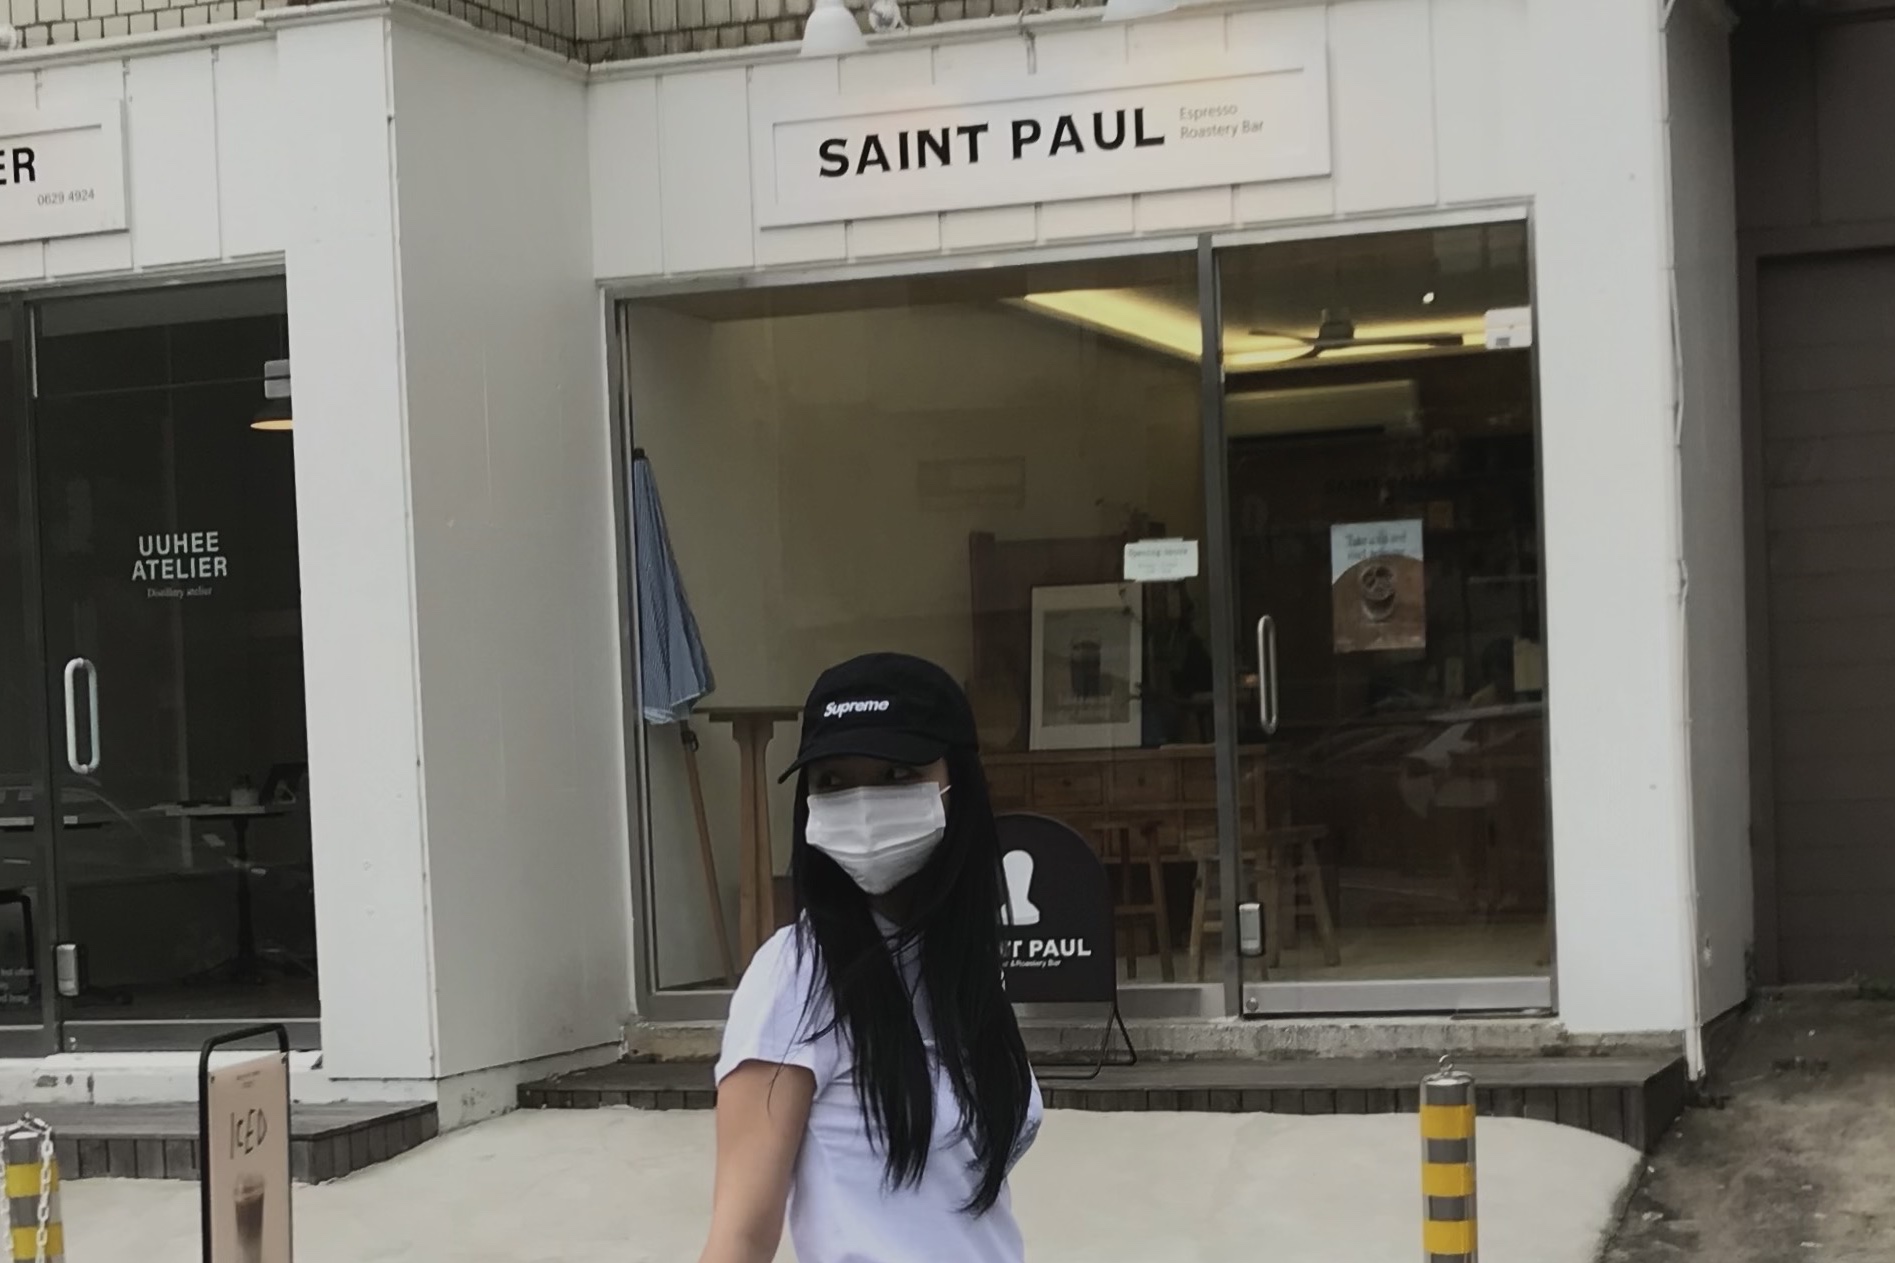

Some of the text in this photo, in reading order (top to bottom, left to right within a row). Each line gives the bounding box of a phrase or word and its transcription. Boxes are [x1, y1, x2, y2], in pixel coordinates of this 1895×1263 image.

[1180, 105, 1238, 121] Espresso
[1180, 120, 1264, 139] Roastery Bar
[819, 107, 1165, 178] SAINT PAUL
[68, 188, 95, 203] 4924
[139, 531, 219, 556] UUHEE
[132, 556, 227, 581] ATELIER
[823, 700, 890, 719] Supreme
[1029, 938, 1092, 958] PAUL
[229, 1107, 268, 1160] ICED
